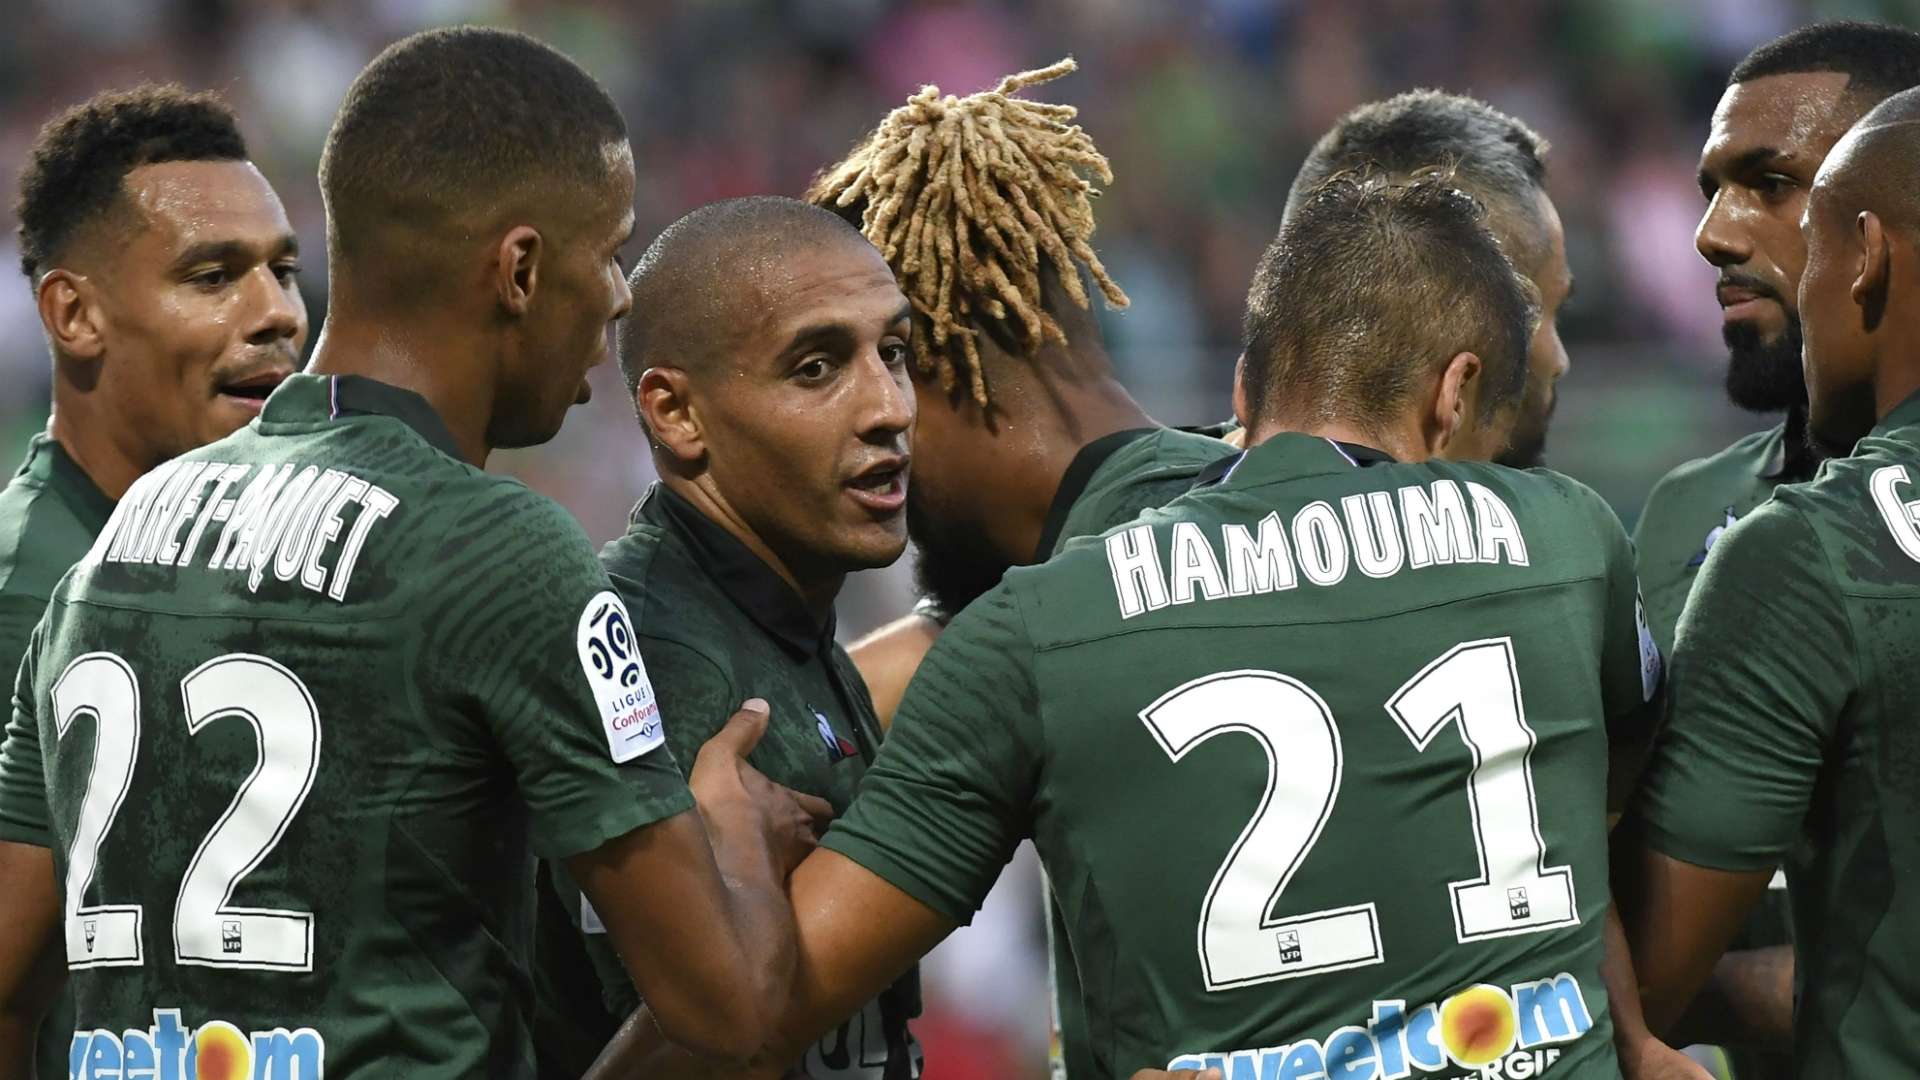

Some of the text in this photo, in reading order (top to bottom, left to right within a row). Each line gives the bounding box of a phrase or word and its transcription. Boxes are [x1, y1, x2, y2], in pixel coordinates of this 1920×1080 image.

[1105, 480, 1530, 619] HAMOUMA
[51, 651, 322, 971] 22
[1138, 636, 1581, 991] 21
[1281, 950, 1301, 961] LFP
